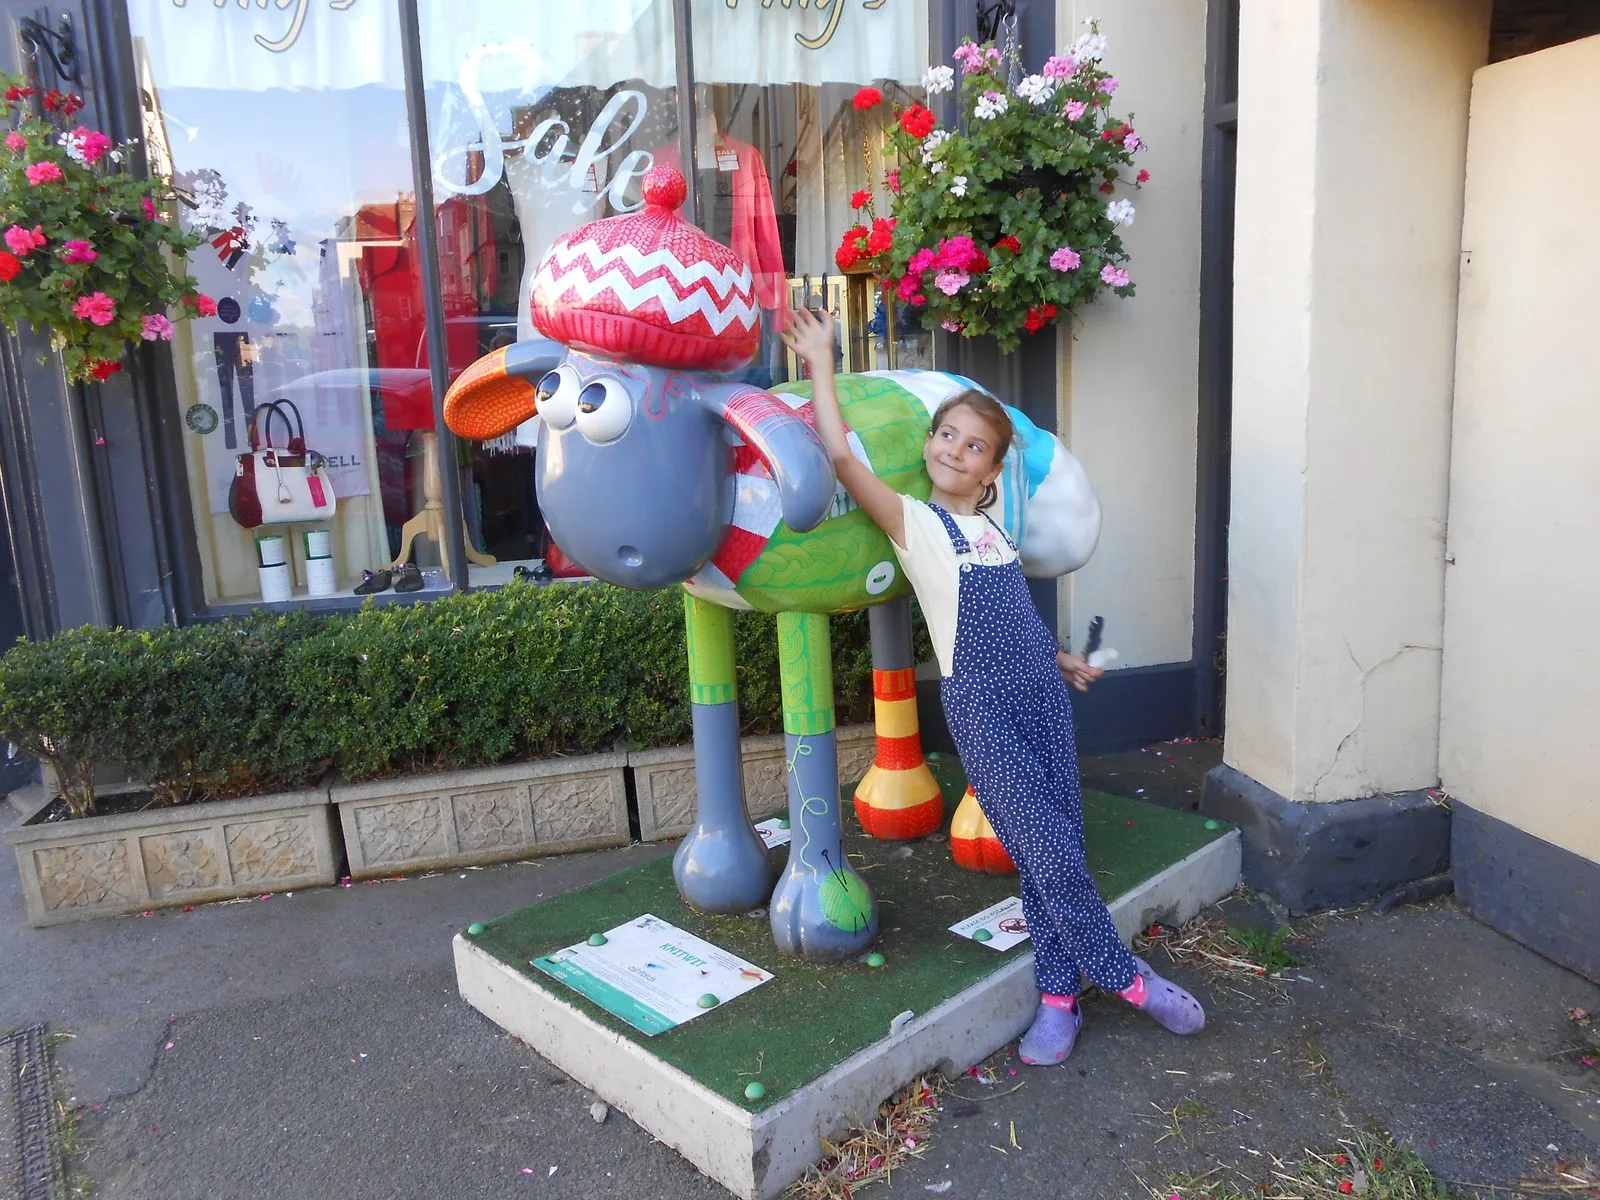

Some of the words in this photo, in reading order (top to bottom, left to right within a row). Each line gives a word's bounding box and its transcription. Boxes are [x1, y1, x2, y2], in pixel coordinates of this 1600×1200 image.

[433, 37, 655, 213] Sale
[328, 455, 361, 468] ELL
[660, 942, 708, 967] KNITWIT
